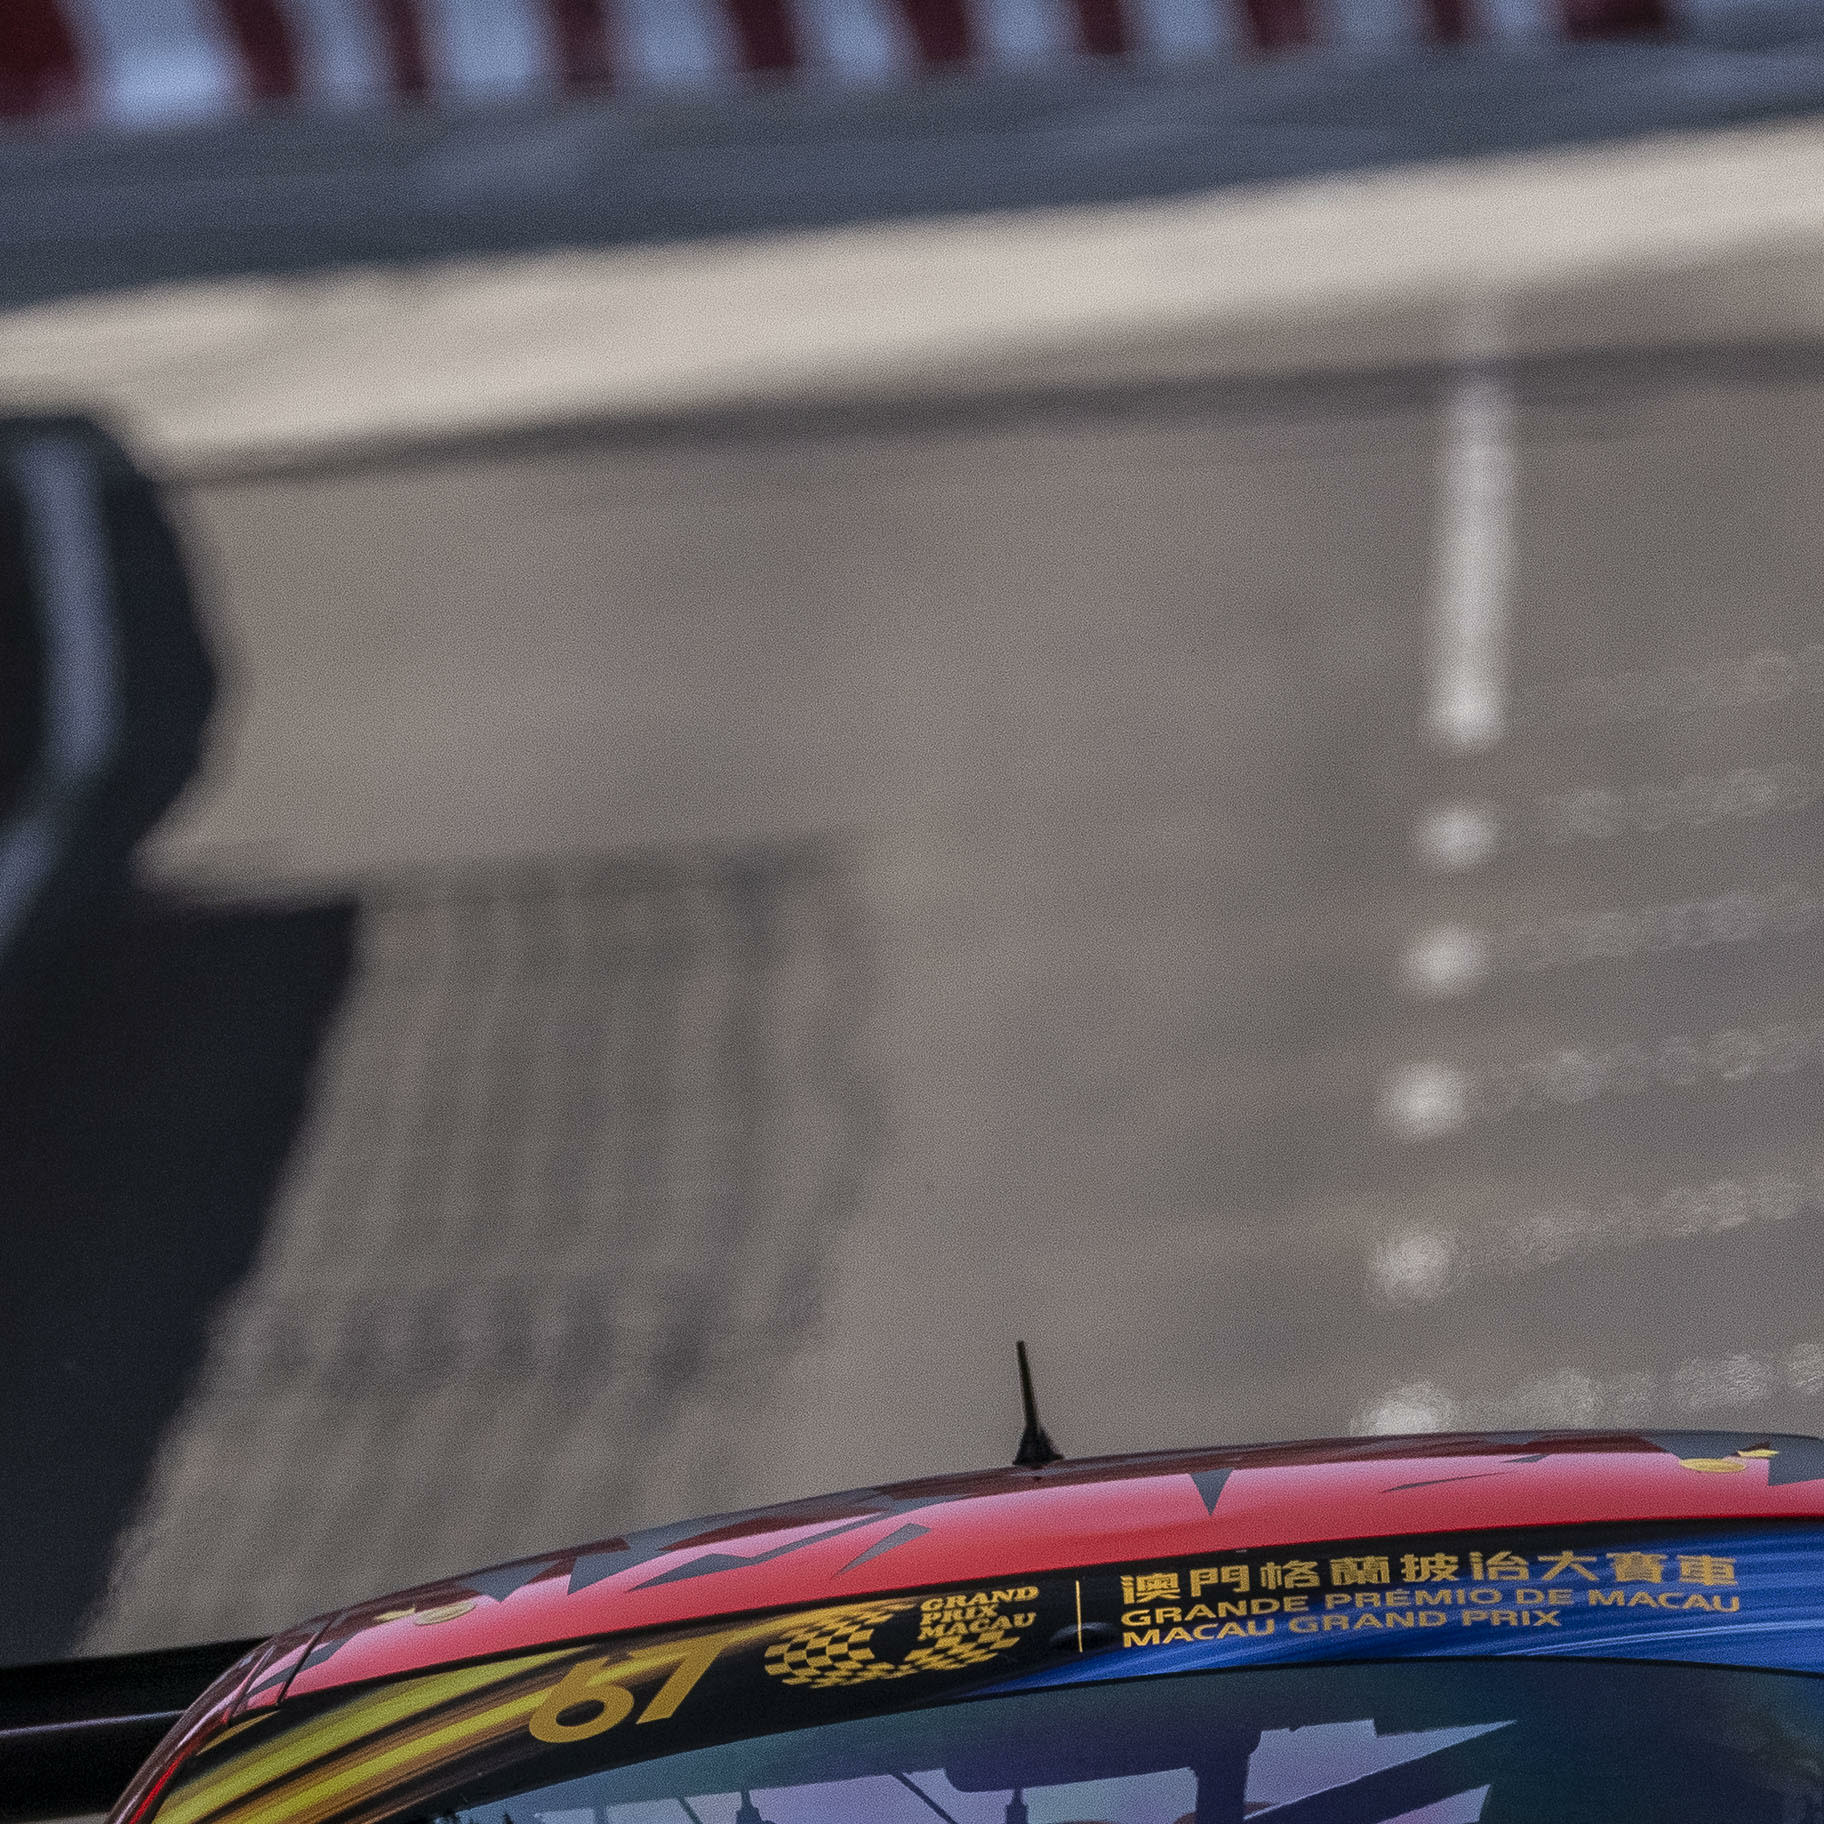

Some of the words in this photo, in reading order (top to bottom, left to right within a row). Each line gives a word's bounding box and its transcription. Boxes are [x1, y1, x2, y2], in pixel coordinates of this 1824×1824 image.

[1120, 1550, 1739, 1605] 澳門格蘭披治大賽車
[919, 1602, 999, 1626] PRIX
[920, 1586, 1039, 1612] GRAND
[1121, 1594, 1309, 1627] GRANDE
[1516, 1588, 1575, 1606] DE
[1588, 1589, 1740, 1613] MACAU
[917, 1611, 1037, 1641] MACAU
[1122, 1618, 1274, 1649] MACAU
[1288, 1610, 1448, 1634] GRAND
[1462, 1609, 1562, 1627] PRIX
[528, 1632, 728, 1744] 67
